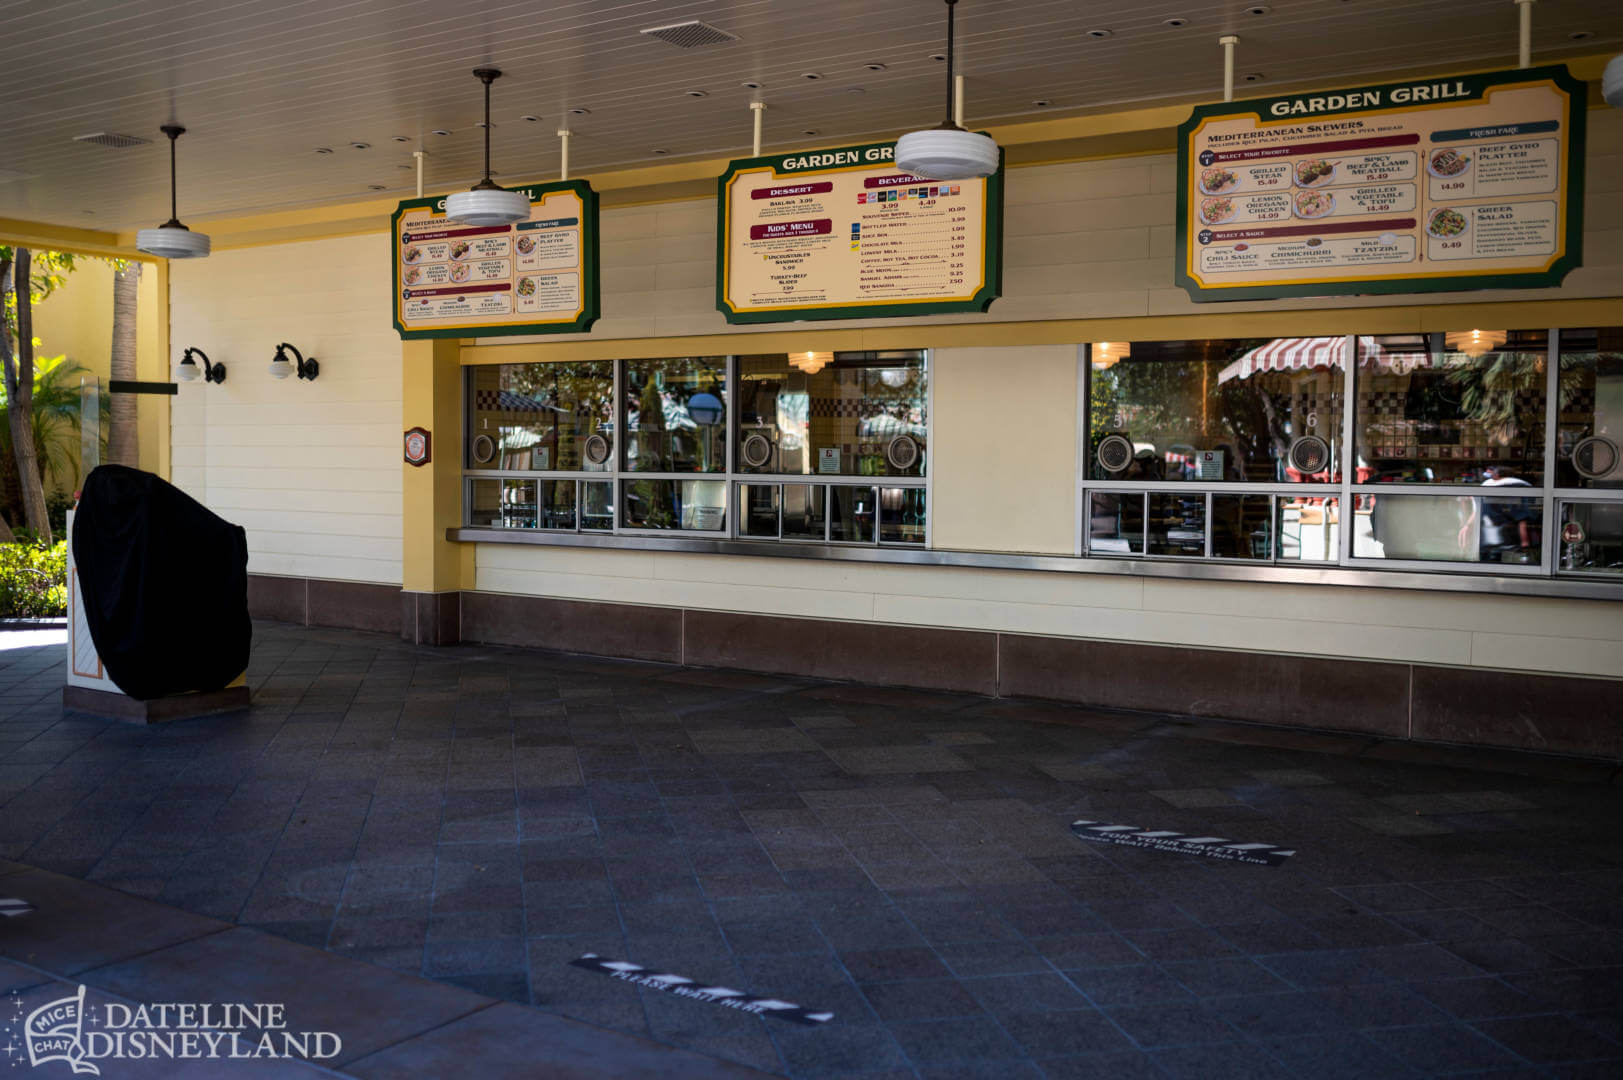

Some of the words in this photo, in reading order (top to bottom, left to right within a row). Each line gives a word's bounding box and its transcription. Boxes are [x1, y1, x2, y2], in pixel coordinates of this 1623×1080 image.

[1270, 91, 1381, 116] GARDEN
[1390, 82, 1471, 103] GRILL
[1208, 127, 1303, 143] MEDITERRANEAN
[1307, 121, 1363, 133] SKEWERS
[1470, 129, 1497, 137] FRESH
[1498, 127, 1519, 135] FARE
[1479, 145, 1507, 153] BEEF
[1510, 143, 1539, 151] GYRO
[783, 151, 859, 170] GARDEN
[1479, 151, 1528, 160] PLATTER
[1250, 166, 1286, 174] GRILLED
[1352, 167, 1402, 175] MEATBALL
[770, 187, 813, 196] DESSERT
[1350, 192, 1404, 200] VEGETABLE
[768, 224, 788, 232] KIDS'
[790, 222, 814, 230] MENU
[1271, 249, 1331, 258] CHIMICHURRI
[483, 418, 488, 429] 1
[595, 418, 602, 429] 2
[756, 416, 764, 429] 3
[1114, 414, 1123, 428] 5
[1306, 413, 1317, 427] 6
[1137, 837, 1180, 846] YOUR
[1184, 843, 1248, 855] SAFETY
[610, 971, 671, 991] PLEASE
[673, 986, 720, 1002] WAIT
[720, 998, 765, 1014] HERE
